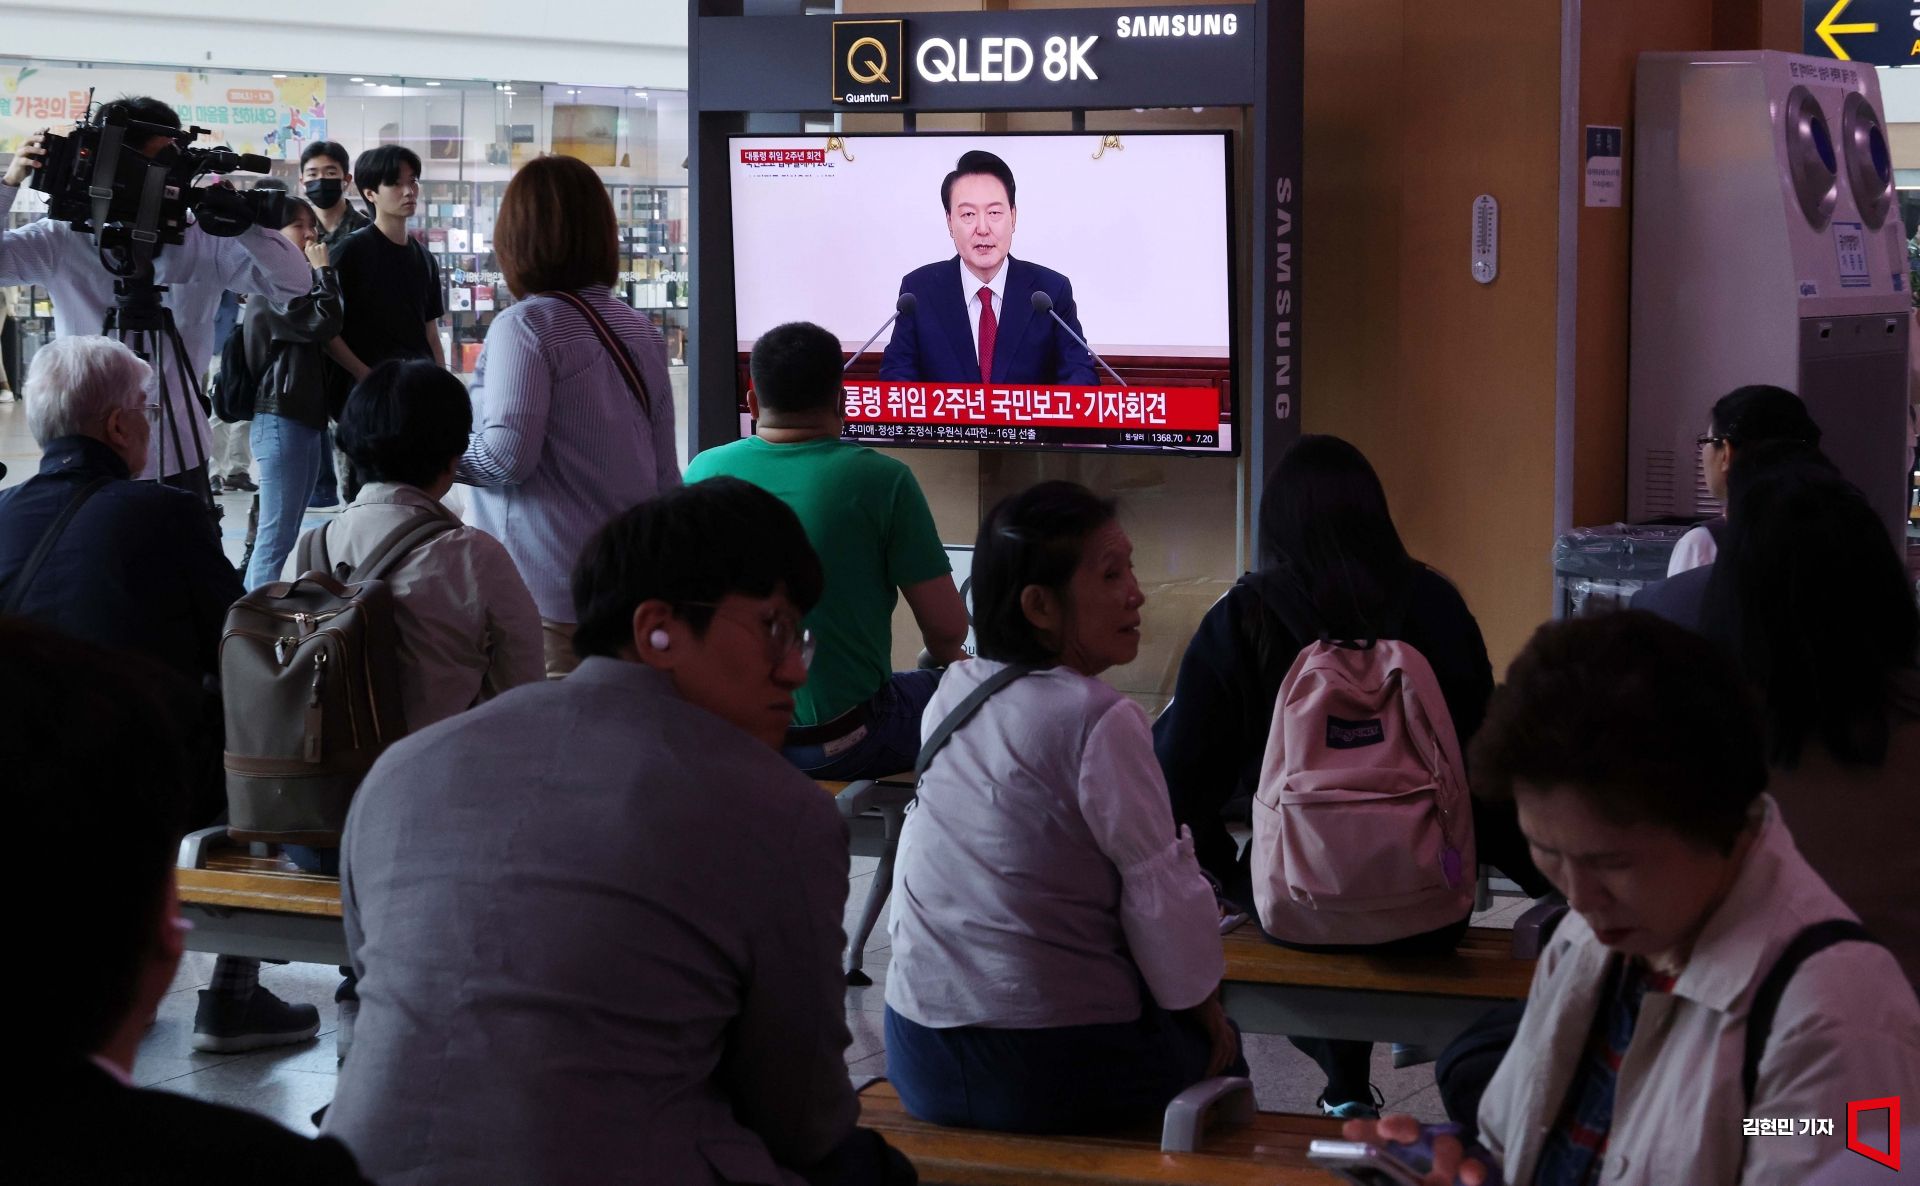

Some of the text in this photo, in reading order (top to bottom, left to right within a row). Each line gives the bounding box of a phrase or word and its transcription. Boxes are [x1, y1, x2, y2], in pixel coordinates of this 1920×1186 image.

[1117, 14, 1237, 37] SAMSUNG
[916, 36, 1098, 82] QLED 8K
[15, 96, 67, 119] 가정의
[846, 93, 888, 103] Quantum
[745, 151, 821, 161] 대통령 취임 2주년 회견
[1275, 177, 1292, 420] SAMSUNG
[844, 386, 881, 418] 통령
[887, 386, 926, 418] 취임
[932, 388, 986, 420] 2주년
[1019, 428, 1036, 440] 선출
[1151, 433, 1183, 443] 1368.70
[1195, 434, 1213, 443] 7.20
